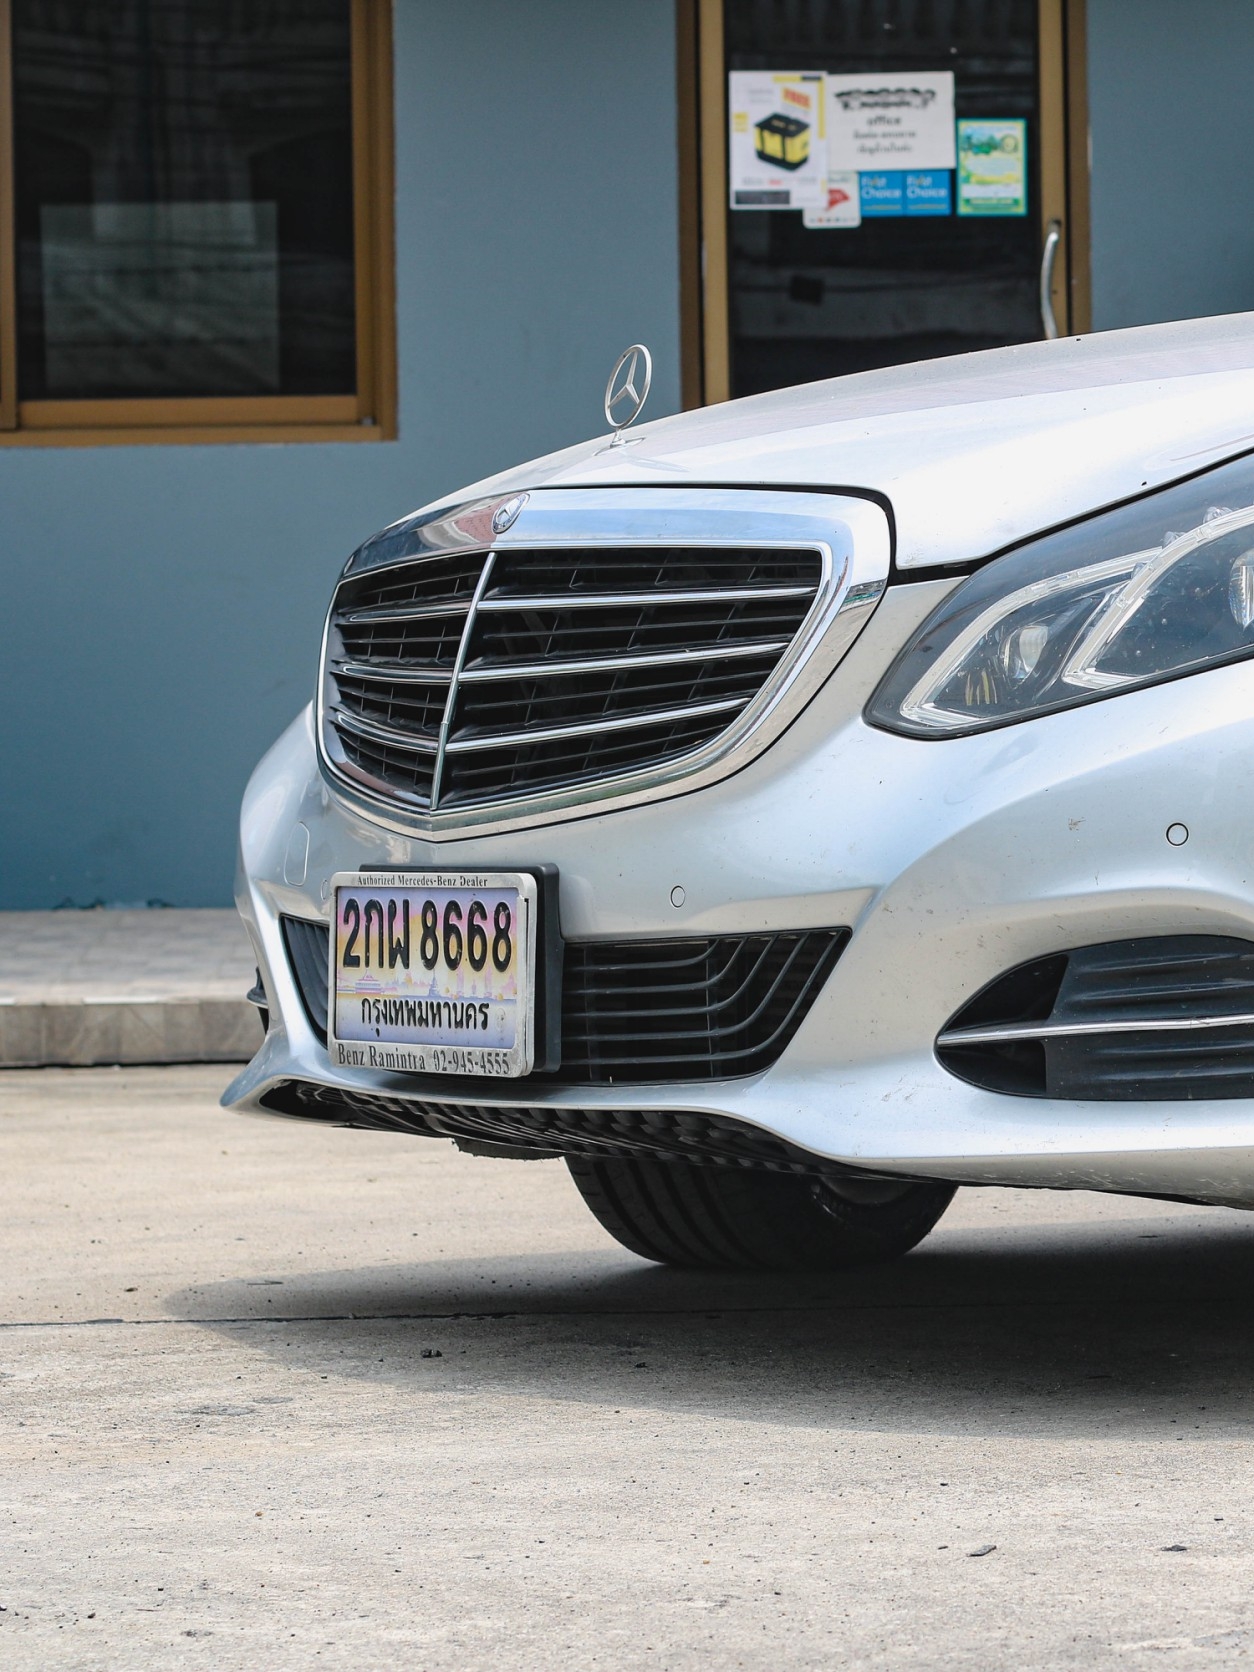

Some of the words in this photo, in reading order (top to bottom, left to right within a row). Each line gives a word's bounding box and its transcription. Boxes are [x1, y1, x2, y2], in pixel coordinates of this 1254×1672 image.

[867, 115, 902, 126] office
[861, 187, 902, 199] Choice
[906, 187, 947, 199] Choice
[357, 875, 395, 886] Authorized
[398, 875, 456, 886] Mercedes-Benz
[459, 876, 488, 887] Dealer
[420, 899, 512, 972] 8668
[361, 997, 490, 1037] กรุงเทพมหานคร
[338, 1043, 365, 1066] Benz
[369, 1045, 426, 1071] Ramintra
[433, 1049, 510, 1075] 02-945-4555
